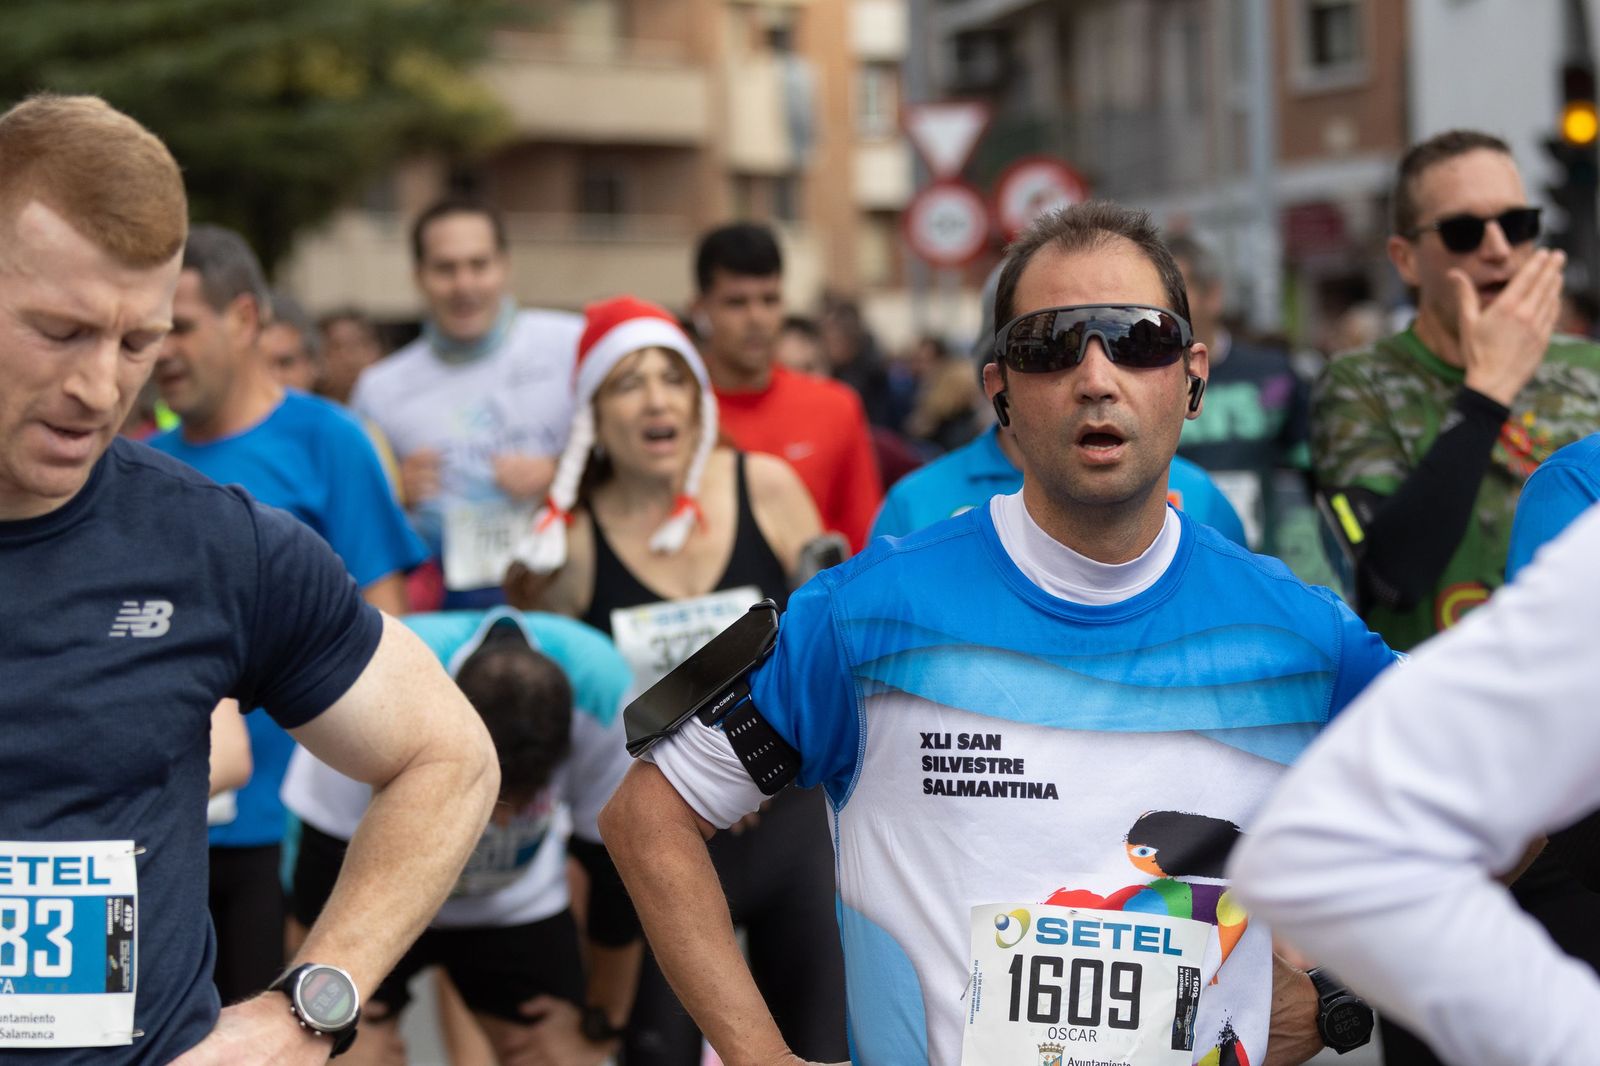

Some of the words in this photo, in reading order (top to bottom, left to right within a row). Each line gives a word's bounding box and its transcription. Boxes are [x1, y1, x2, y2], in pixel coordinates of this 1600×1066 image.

[920, 732, 951, 749] XLI
[957, 733, 1001, 750] SAN
[922, 755, 1024, 775] SILVESTRE
[923, 778, 1059, 800] SALMANTINA
[0, 898, 74, 978] 83
[1036, 917, 1183, 956] SETEL
[1008, 954, 1143, 1030] 1609
[1047, 1026, 1097, 1043] OSCAR
